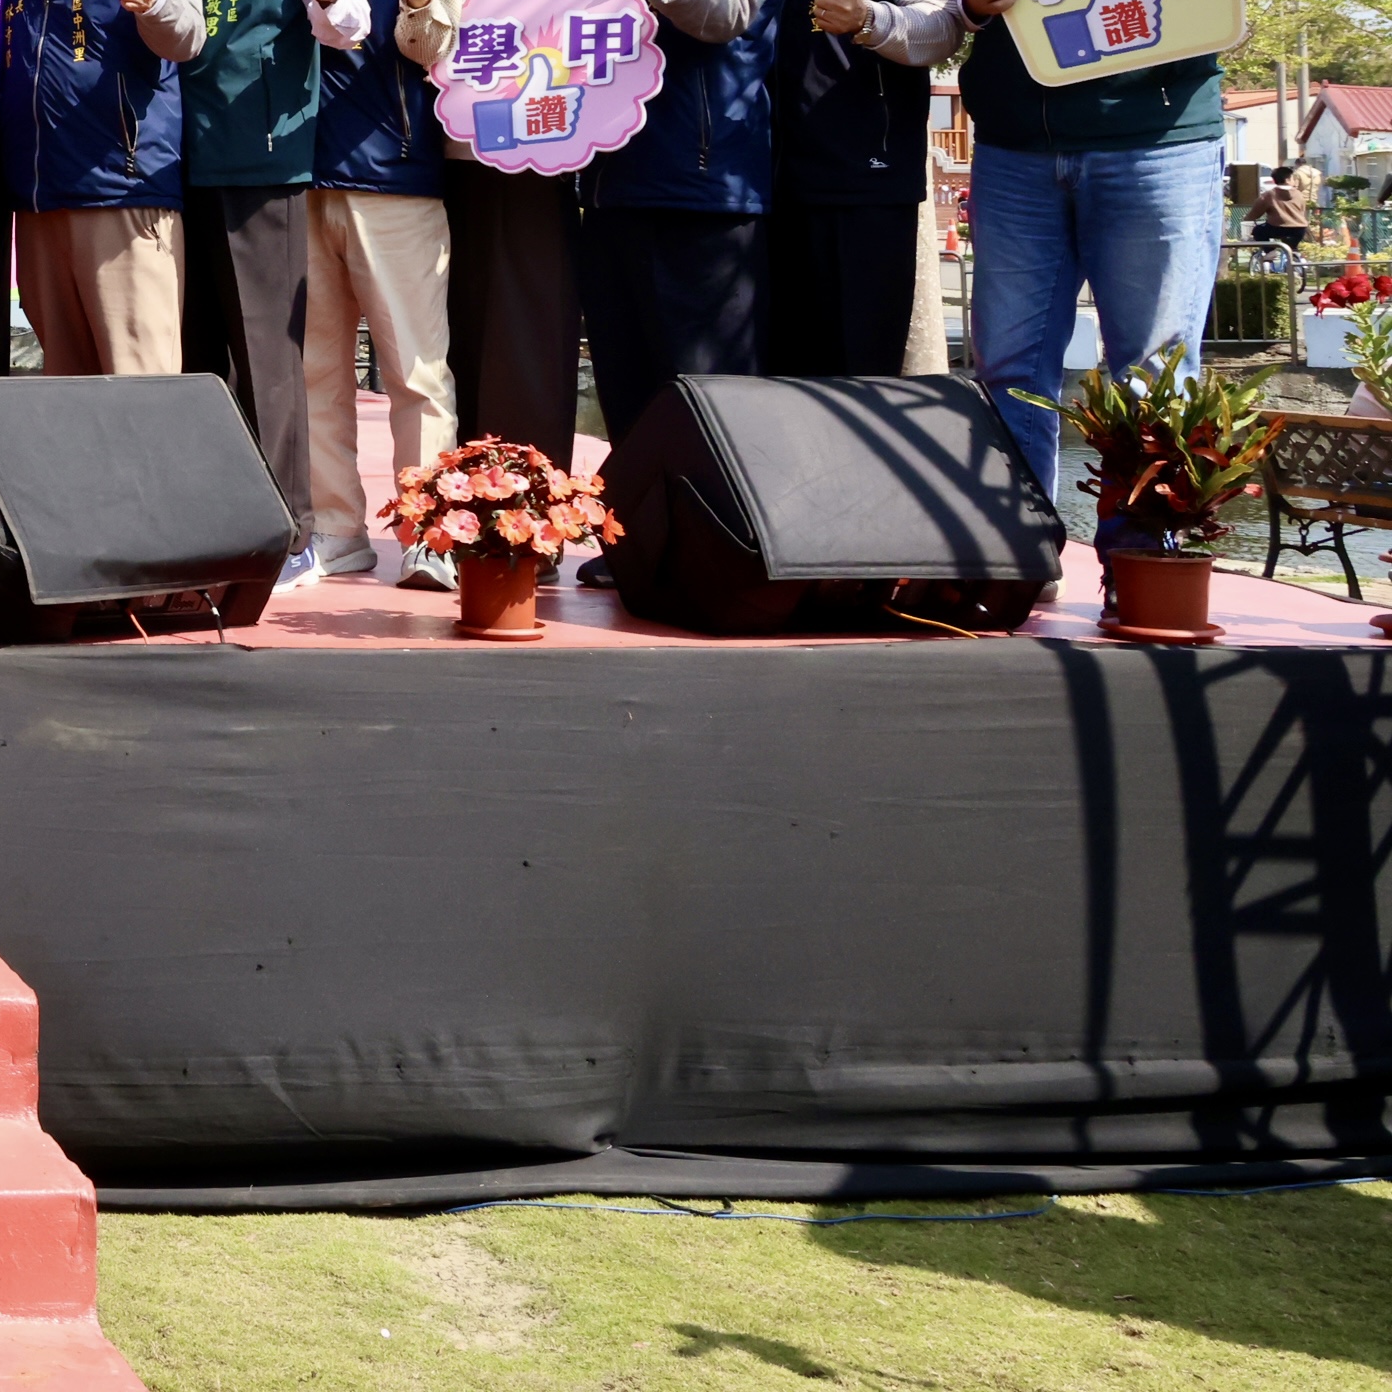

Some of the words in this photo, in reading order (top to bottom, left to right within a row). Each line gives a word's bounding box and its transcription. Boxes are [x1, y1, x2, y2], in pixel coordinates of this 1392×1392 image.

[1099, 0, 1151, 46] 讚
[452, 13, 637, 85] 學甲
[524, 94, 567, 136] 讚
